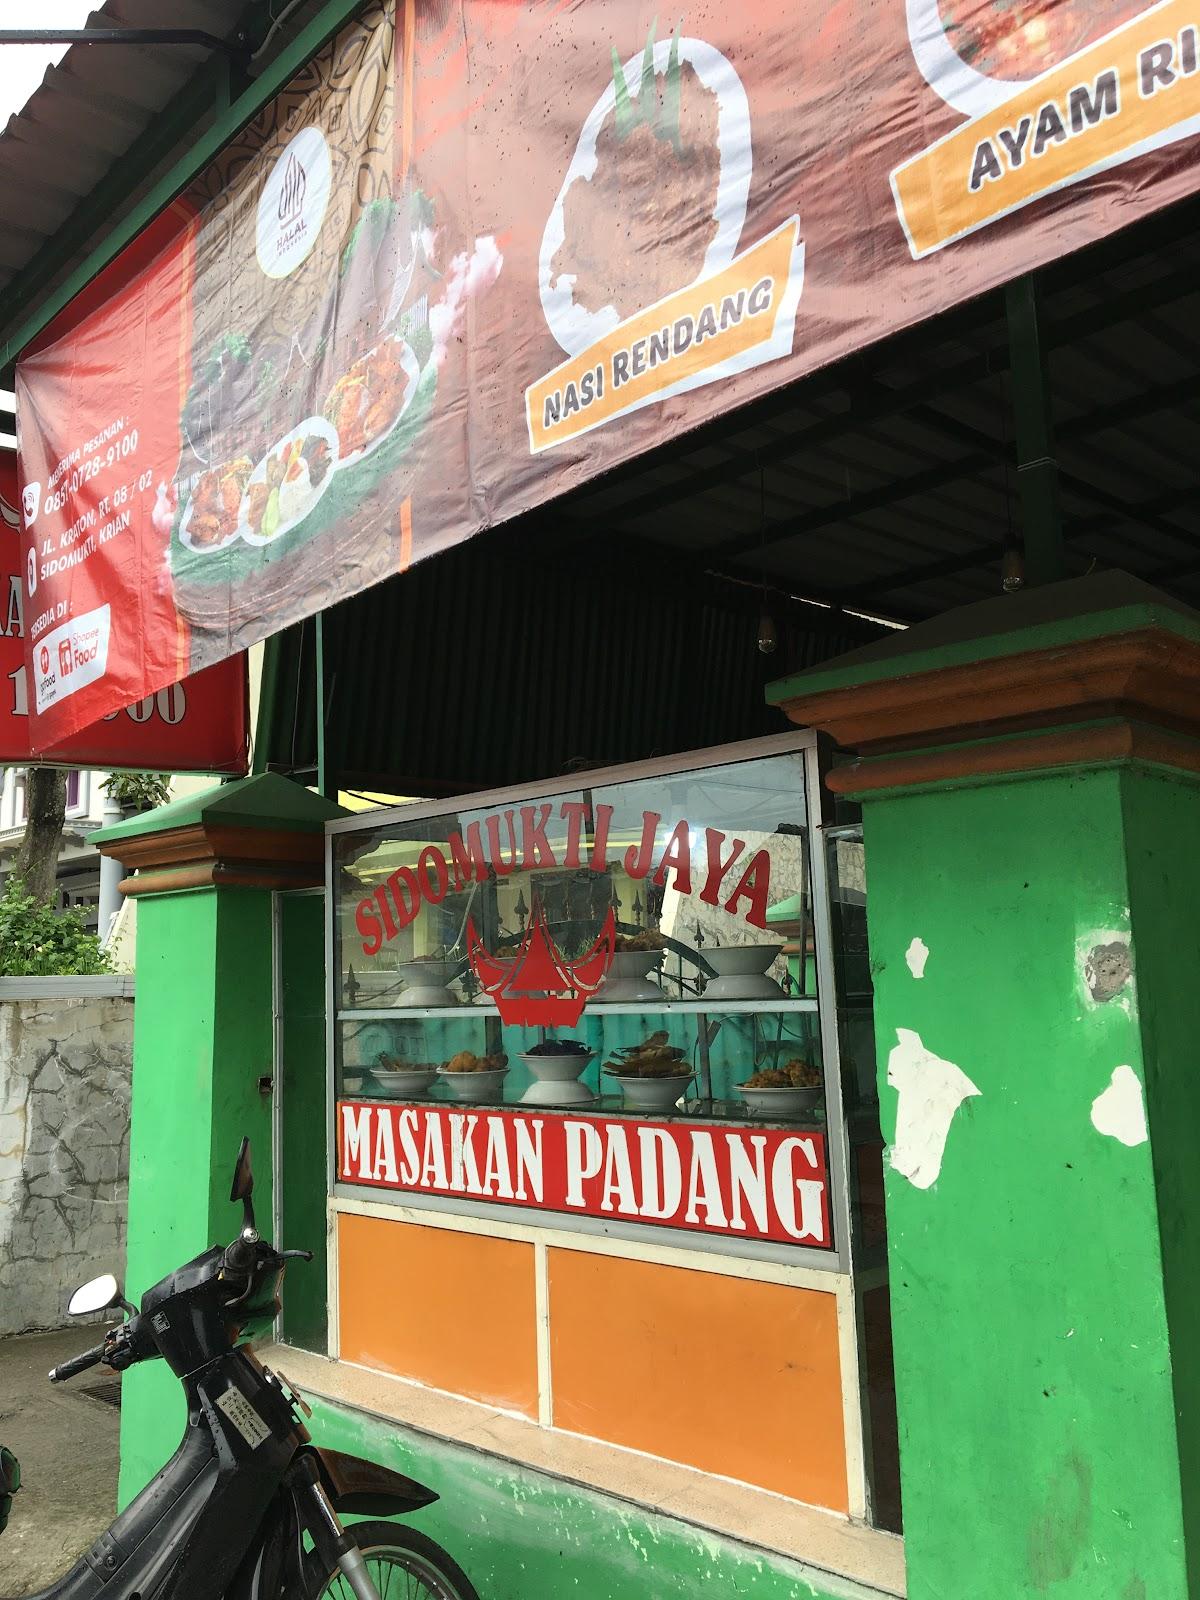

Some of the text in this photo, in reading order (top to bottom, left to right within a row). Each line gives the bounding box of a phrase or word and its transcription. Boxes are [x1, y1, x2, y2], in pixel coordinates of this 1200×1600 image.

[970, 70, 1118, 190] AYAM
[276, 219, 308, 251] HALAL
[543, 277, 773, 428] NASI RENDANG
[83, 416, 124, 456] PESANAN
[40, 509, 131, 581] SIDOMUKTI, KRIAN
[41, 537, 56, 557] JL.
[60, 508, 97, 549] KRATON,
[98, 496, 111, 520] RT.
[113, 485, 128, 508] 08
[138, 468, 153, 493] 02
[56, 599, 67, 620] DI
[73, 627, 100, 647] Shopee
[73, 639, 99, 670] Food
[355, 802, 772, 956] SIDOMUKTI JAYA
[342, 1102, 825, 1242] MASAKAN PADANG
